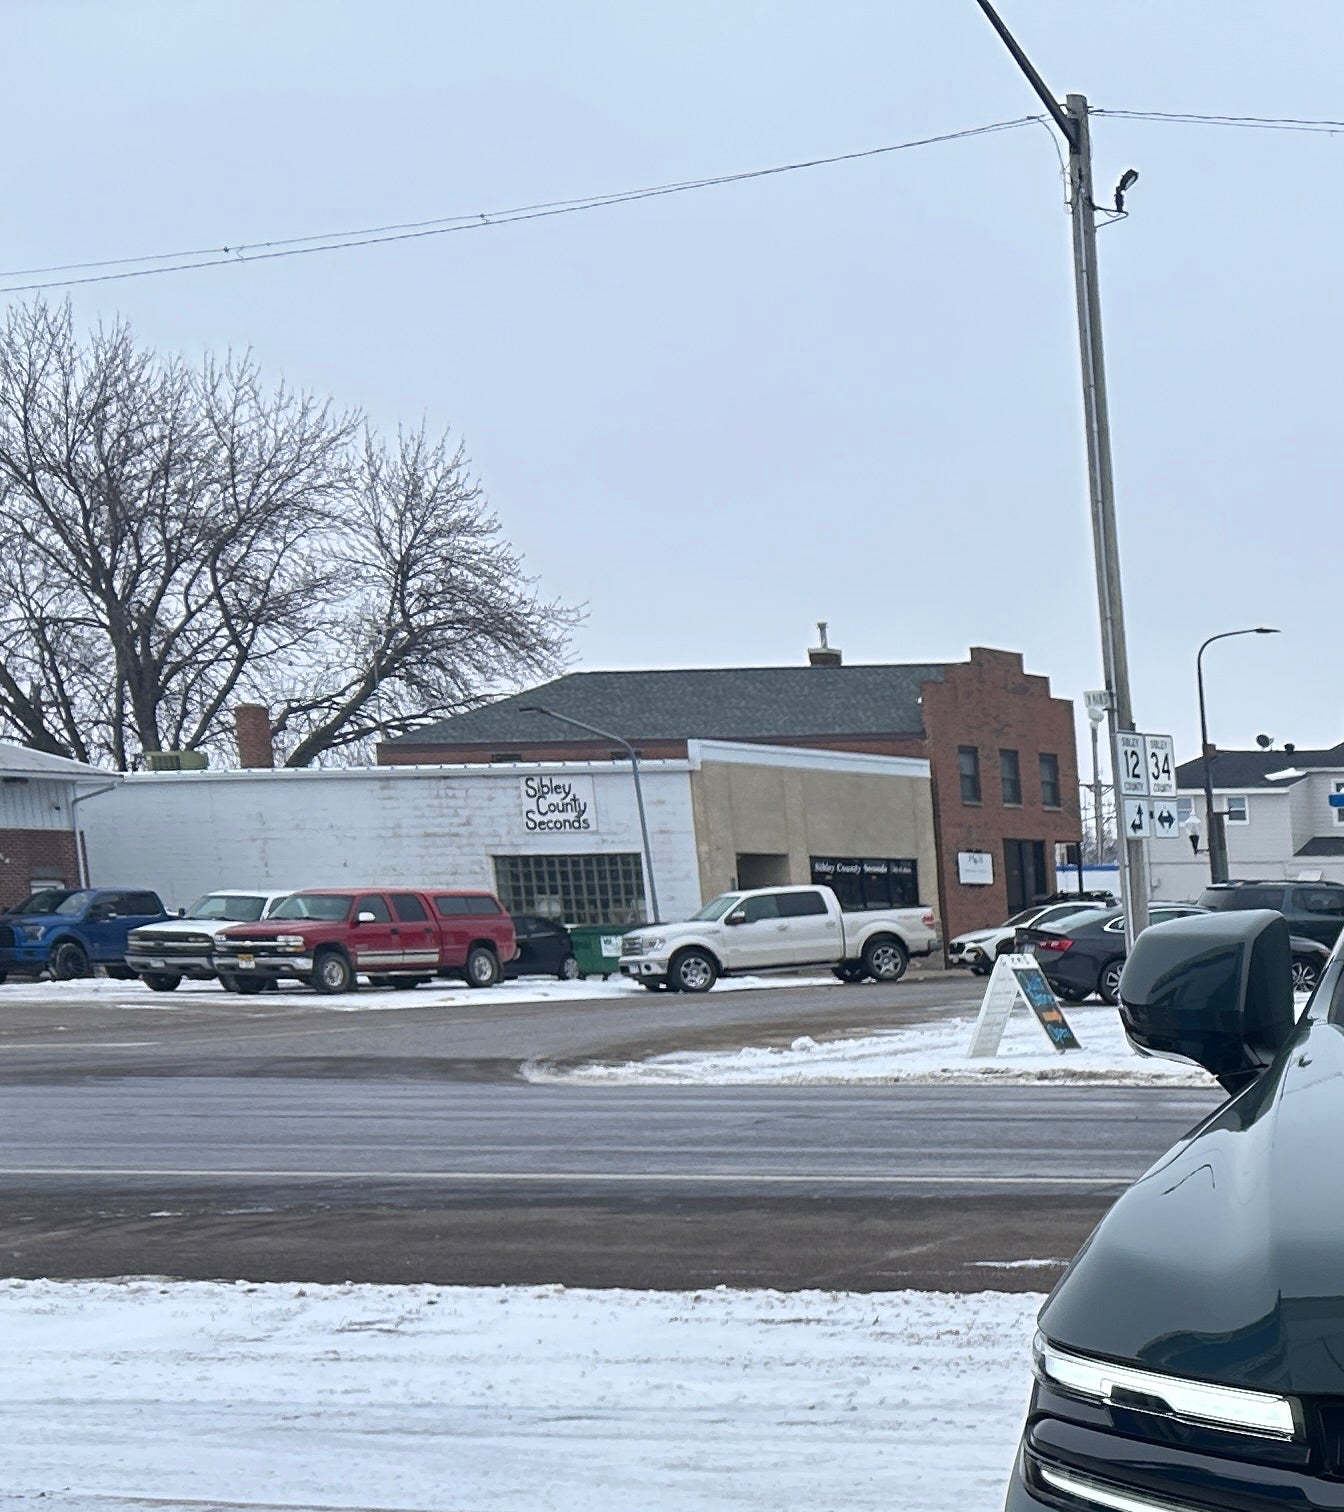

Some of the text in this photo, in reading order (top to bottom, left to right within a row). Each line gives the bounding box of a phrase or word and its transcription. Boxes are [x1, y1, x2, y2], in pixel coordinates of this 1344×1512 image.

[1123, 750, 1141, 779] 12
[1150, 752, 1171, 781] 34
[525, 777, 571, 800] Sibley
[536, 793, 587, 818] County
[525, 809, 590, 830] Seconds
